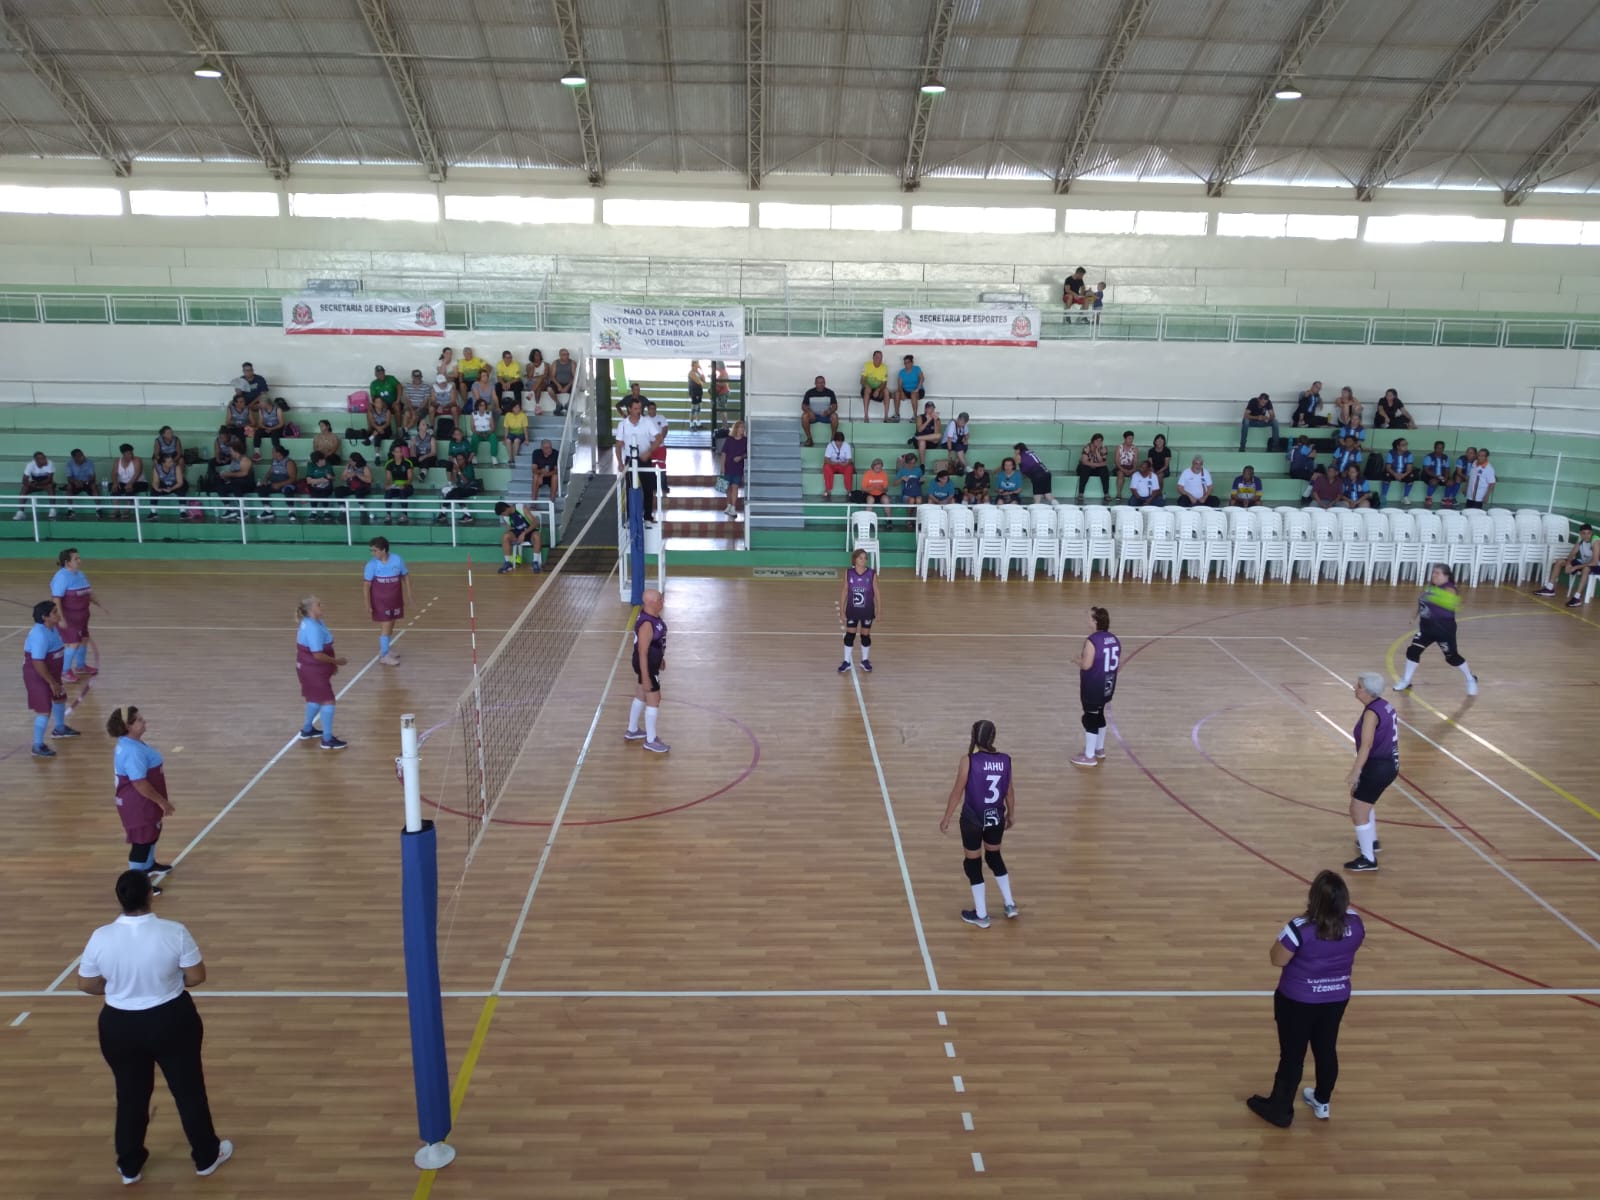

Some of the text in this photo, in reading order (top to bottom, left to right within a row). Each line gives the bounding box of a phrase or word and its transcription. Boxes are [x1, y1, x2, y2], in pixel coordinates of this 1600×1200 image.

[319, 303, 411, 313] SECRETARIA DE ESPORTES
[659, 309, 680, 317] PARA
[645, 318, 657, 326] DE
[696, 319, 734, 328] PAULISTA
[919, 314, 1008, 324] SECRETARIA DE ESPORTES
[656, 328, 694, 337] LEMBRAR
[696, 329, 710, 338] DO
[644, 338, 685, 347] VOLEIBOL
[1103, 644, 1119, 672] 15
[983, 761, 1004, 771] JAHU
[984, 775, 1002, 803] 3
[1311, 983, 1346, 993] TÉCNICA
